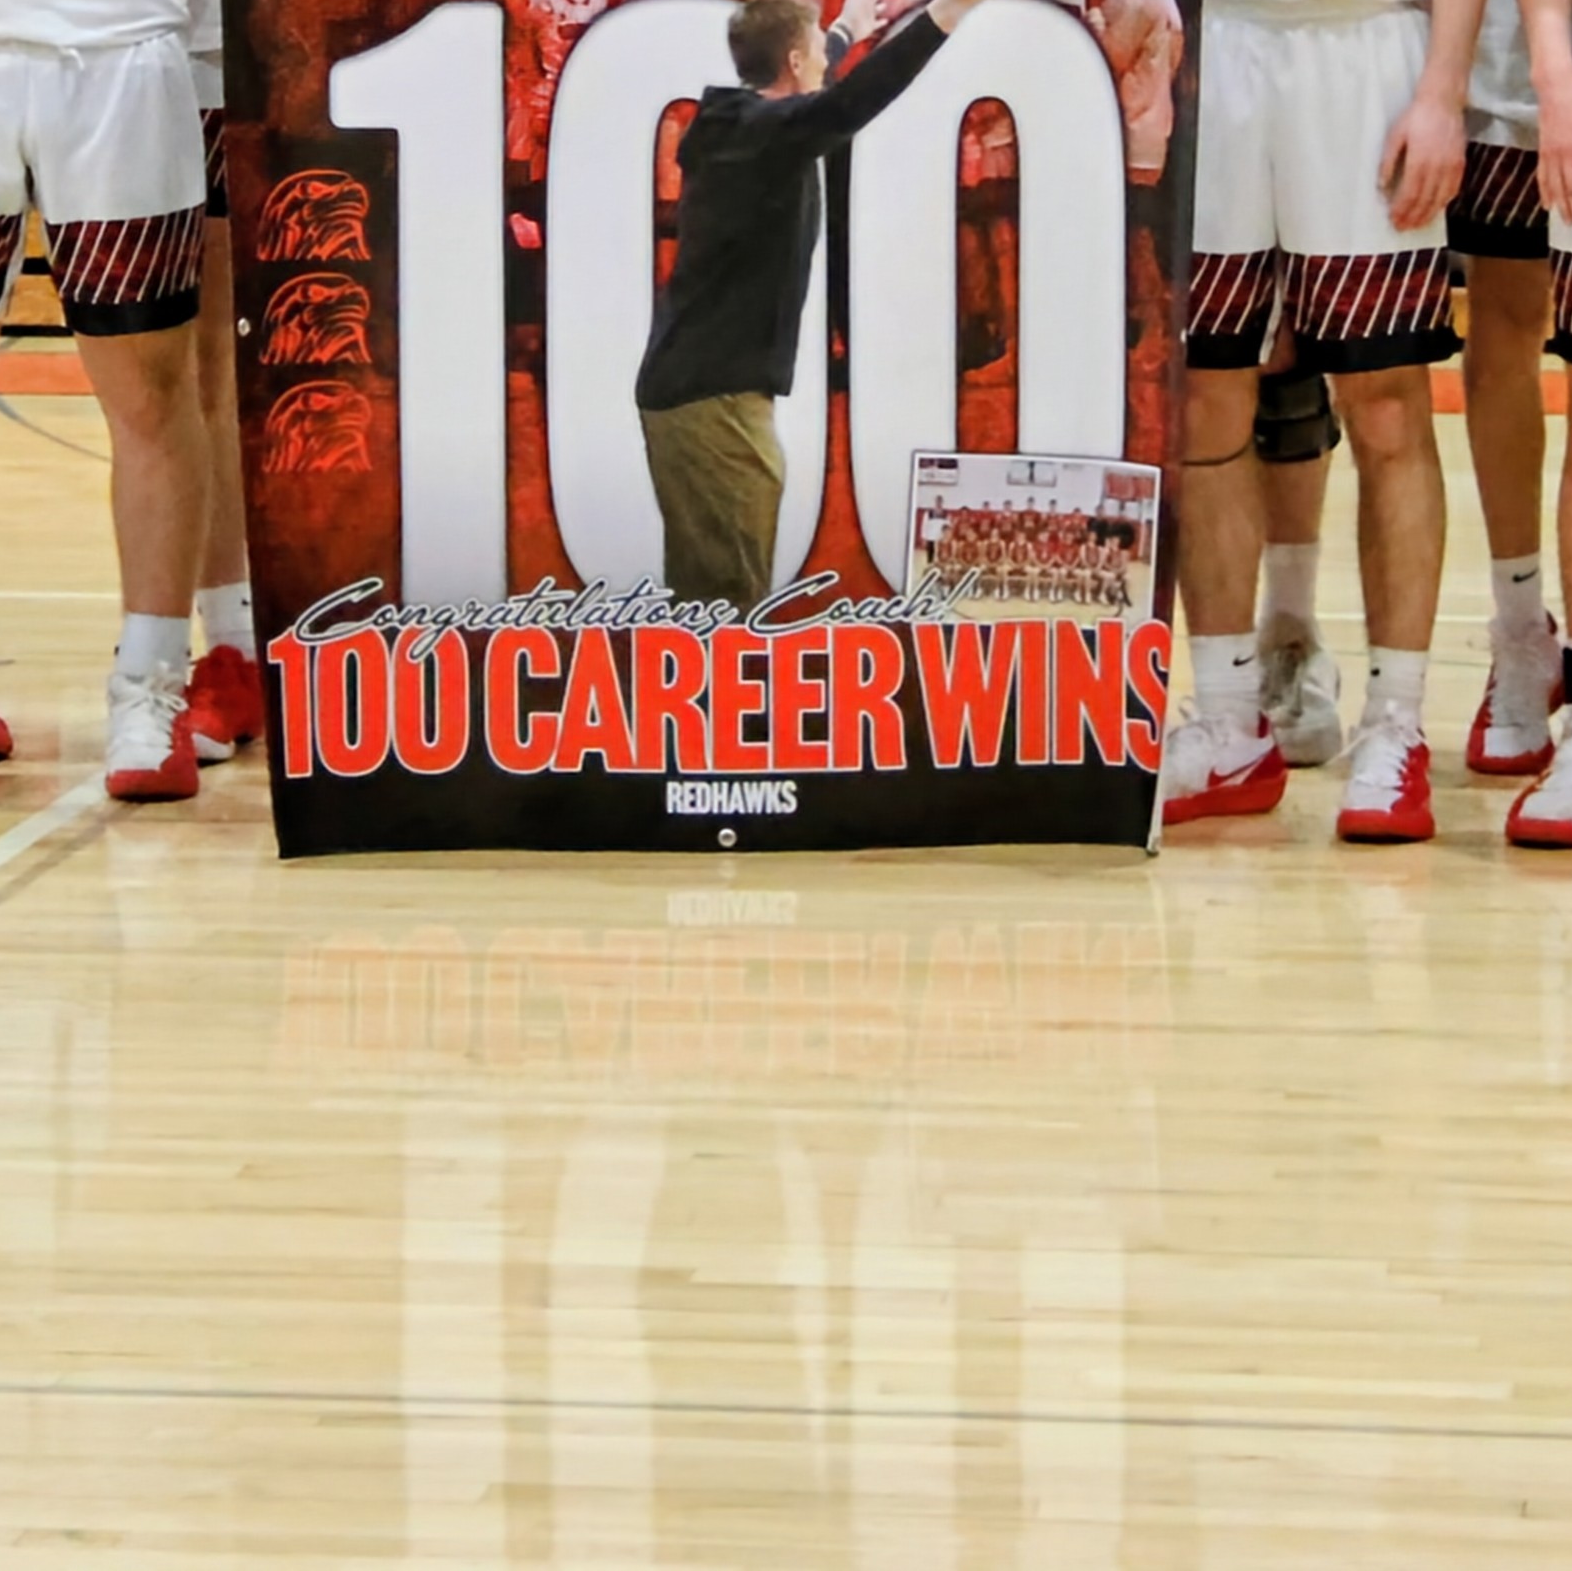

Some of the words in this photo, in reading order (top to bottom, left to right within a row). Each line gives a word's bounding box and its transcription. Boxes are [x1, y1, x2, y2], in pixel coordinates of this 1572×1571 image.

[296, 577, 735, 663] Congratulations
[746, 567, 981, 637] Coach!
[268, 627, 471, 779] 100
[485, 625, 906, 774] CAREER
[915, 619, 1172, 771] WINS
[665, 781, 797, 815] REDHAWKS
